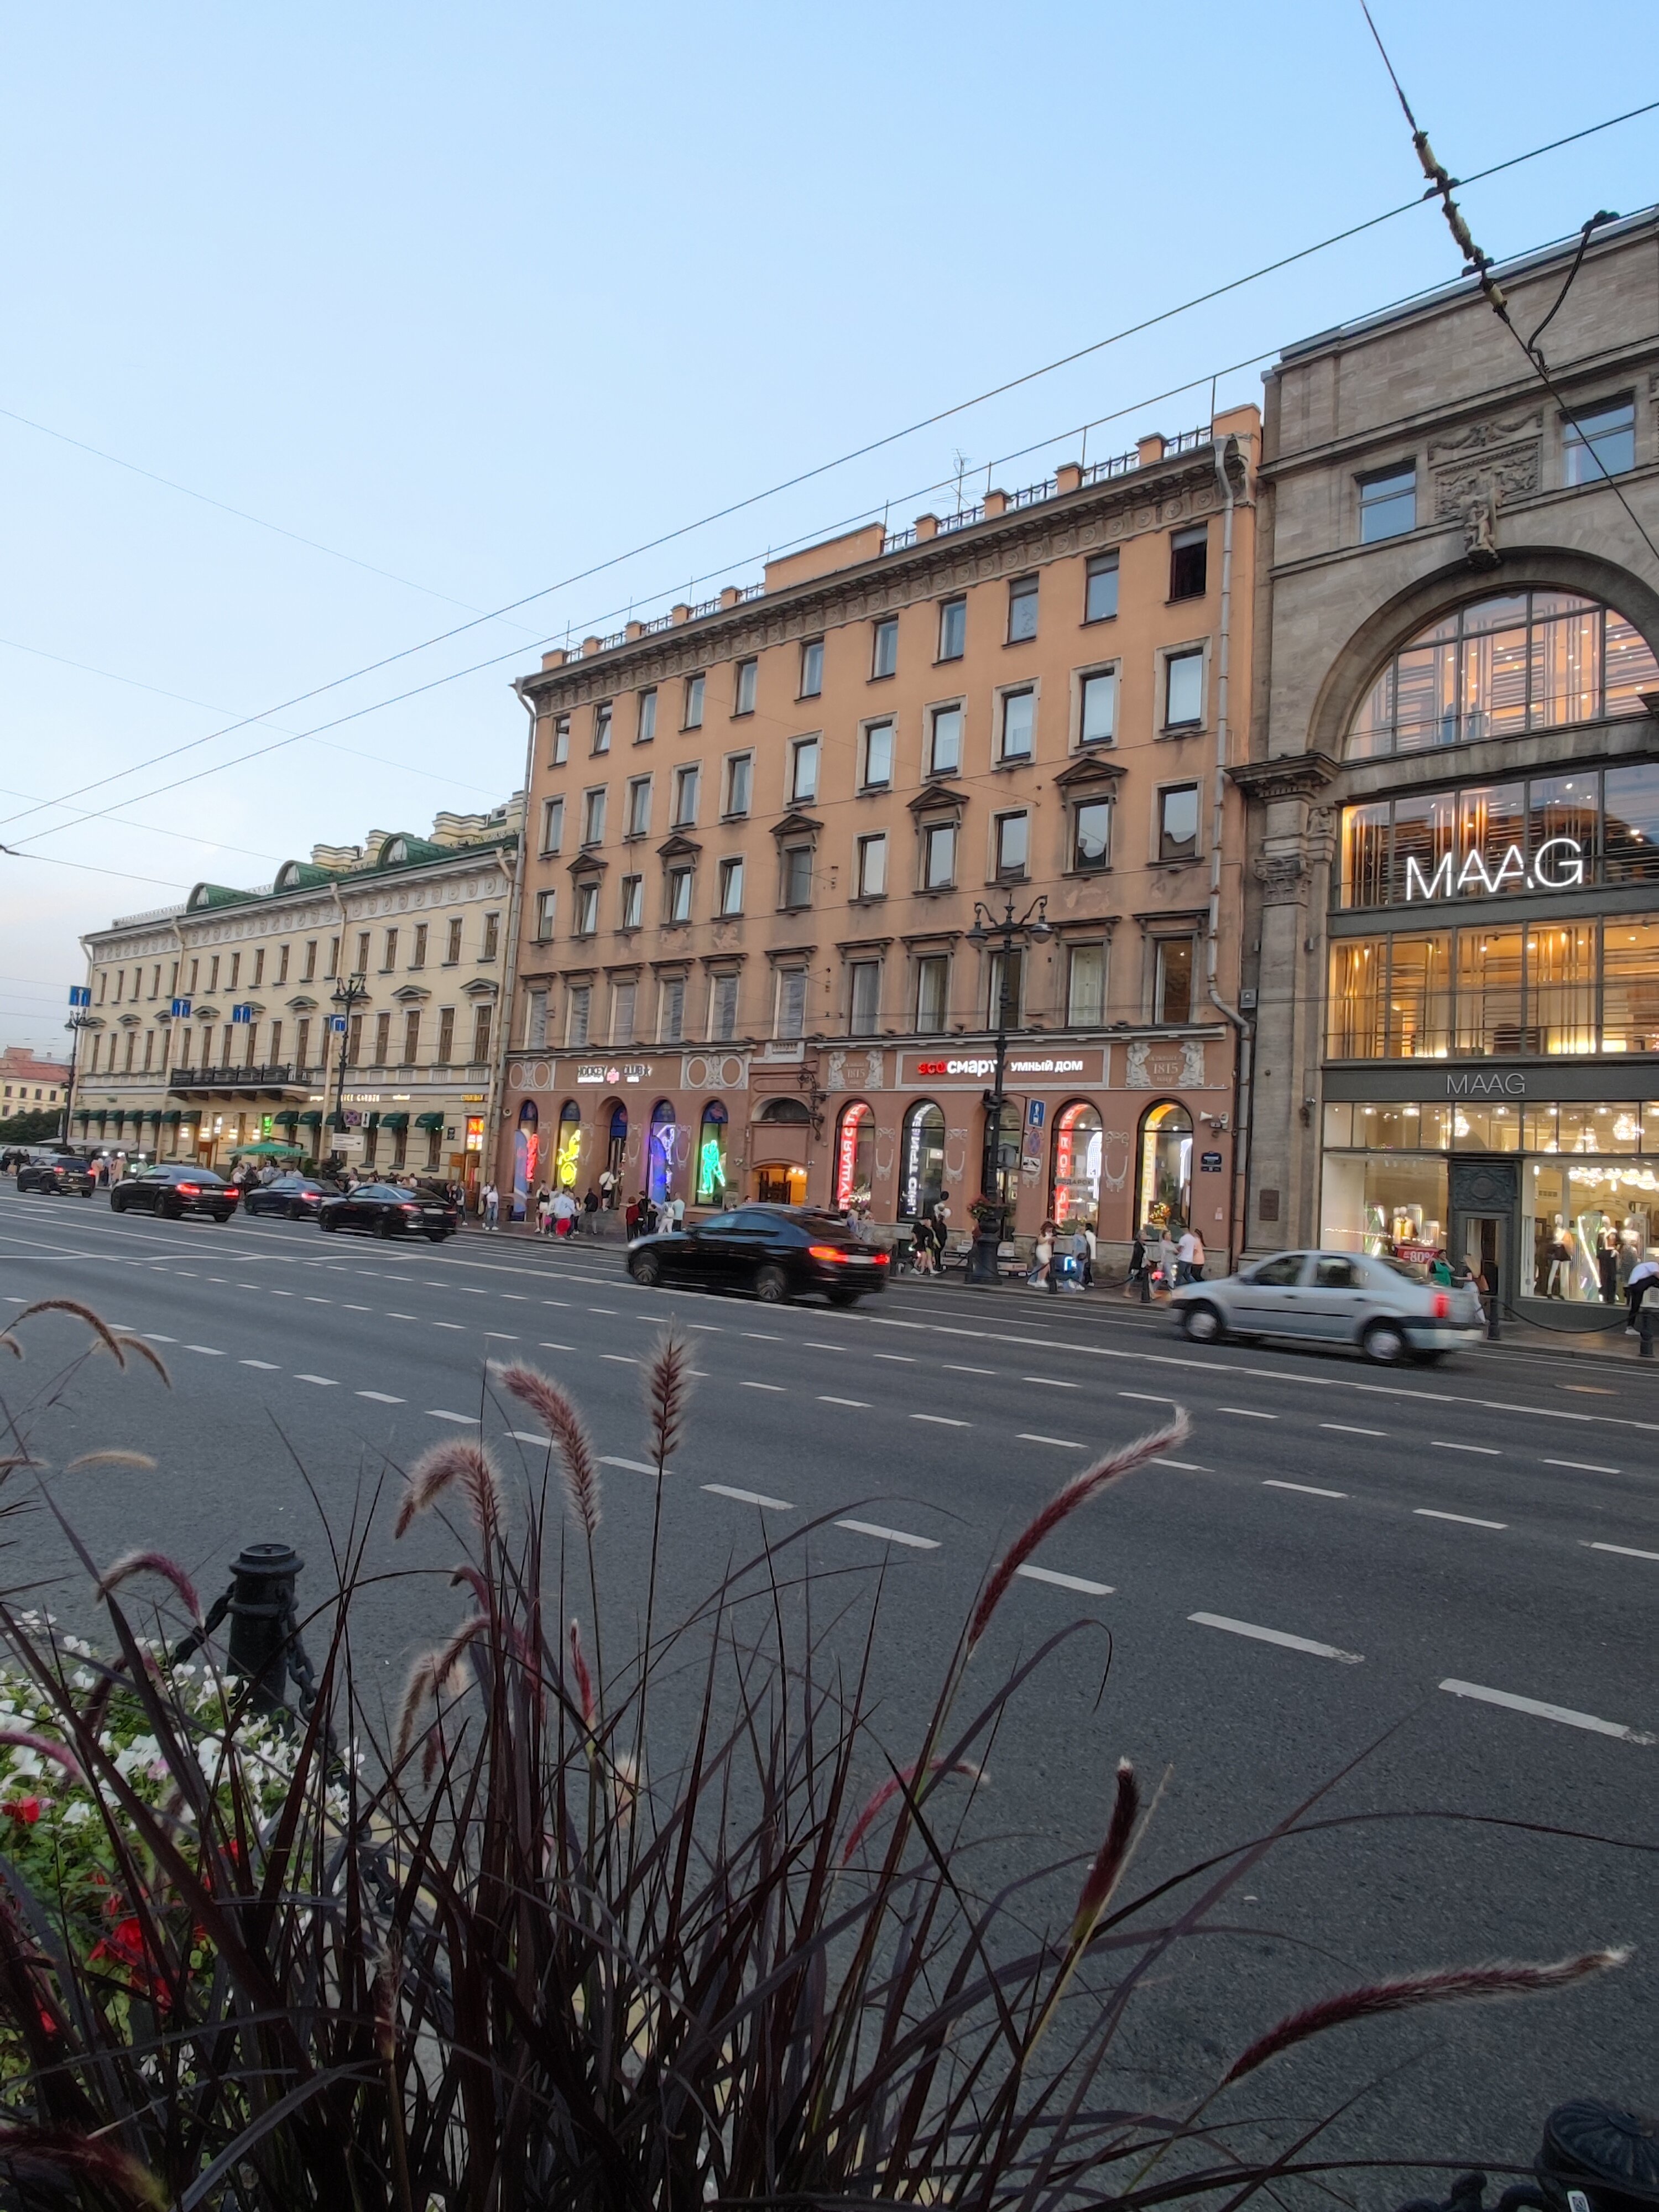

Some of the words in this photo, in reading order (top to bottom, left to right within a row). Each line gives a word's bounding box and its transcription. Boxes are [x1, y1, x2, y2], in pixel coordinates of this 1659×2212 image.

[1406, 838, 1583, 901] MAAG
[1154, 1063, 1178, 1075] 1815
[1447, 1073, 1525, 1094] MAAG
